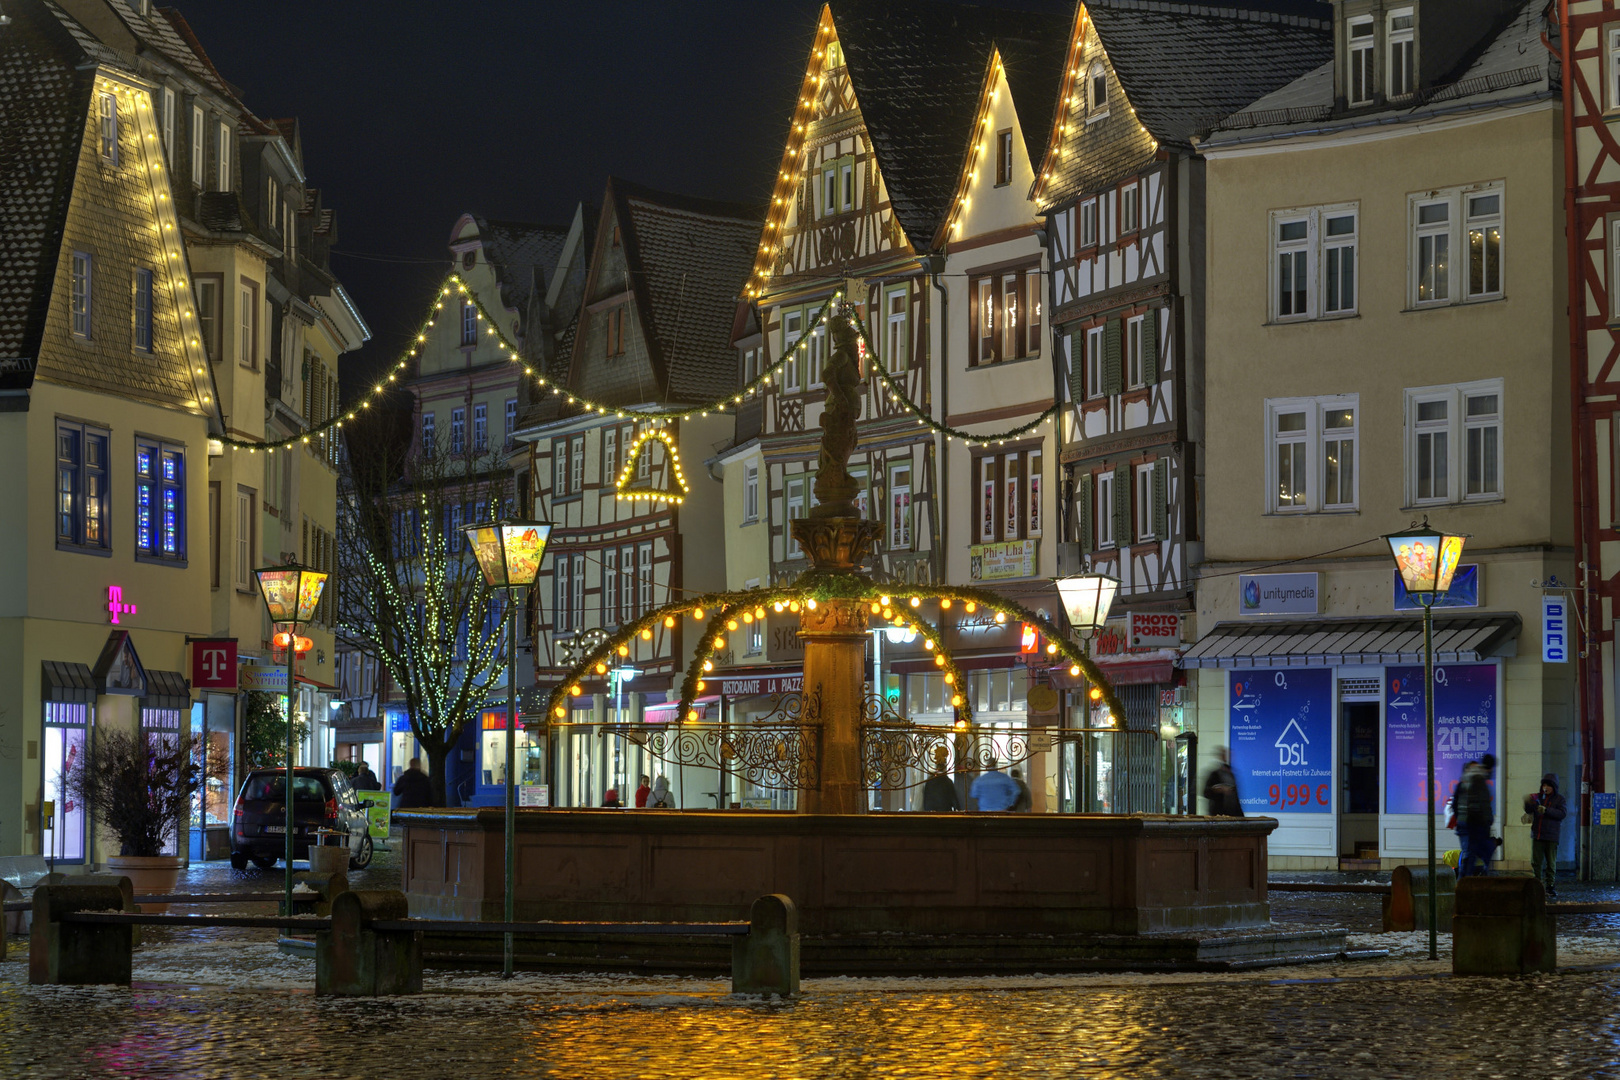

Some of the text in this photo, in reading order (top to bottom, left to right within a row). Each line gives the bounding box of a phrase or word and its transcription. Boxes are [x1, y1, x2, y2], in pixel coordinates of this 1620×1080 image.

[983, 546, 997, 558] Phi
[1005, 544, 1023, 556] Lha
[1263, 587, 1315, 603] unitymedia
[1132, 614, 1178, 626] PHOTO
[1132, 625, 1177, 637] PORST
[1546, 604, 1563, 660] BERG
[202, 649, 227, 680] T
[253, 669, 288, 678] Juwelier
[722, 680, 760, 695] RISTORANTE
[767, 679, 777, 693] LA
[1160, 689, 1183, 706] FOT
[1438, 715, 1489, 724] Allnet & SMS Flat
[1437, 726, 1490, 752] 20GB
[1279, 743, 1309, 766] DSL
[1442, 752, 1464, 760] Internet
[1464, 752, 1474, 760] Flat
[1252, 769, 1271, 777] Internet
[1271, 769, 1282, 777] und
[1282, 769, 1302, 777] Festnetz
[1310, 769, 1332, 777] Zuhause
[1268, 783, 1311, 810] 9,99
[1315, 783, 1329, 806] €
